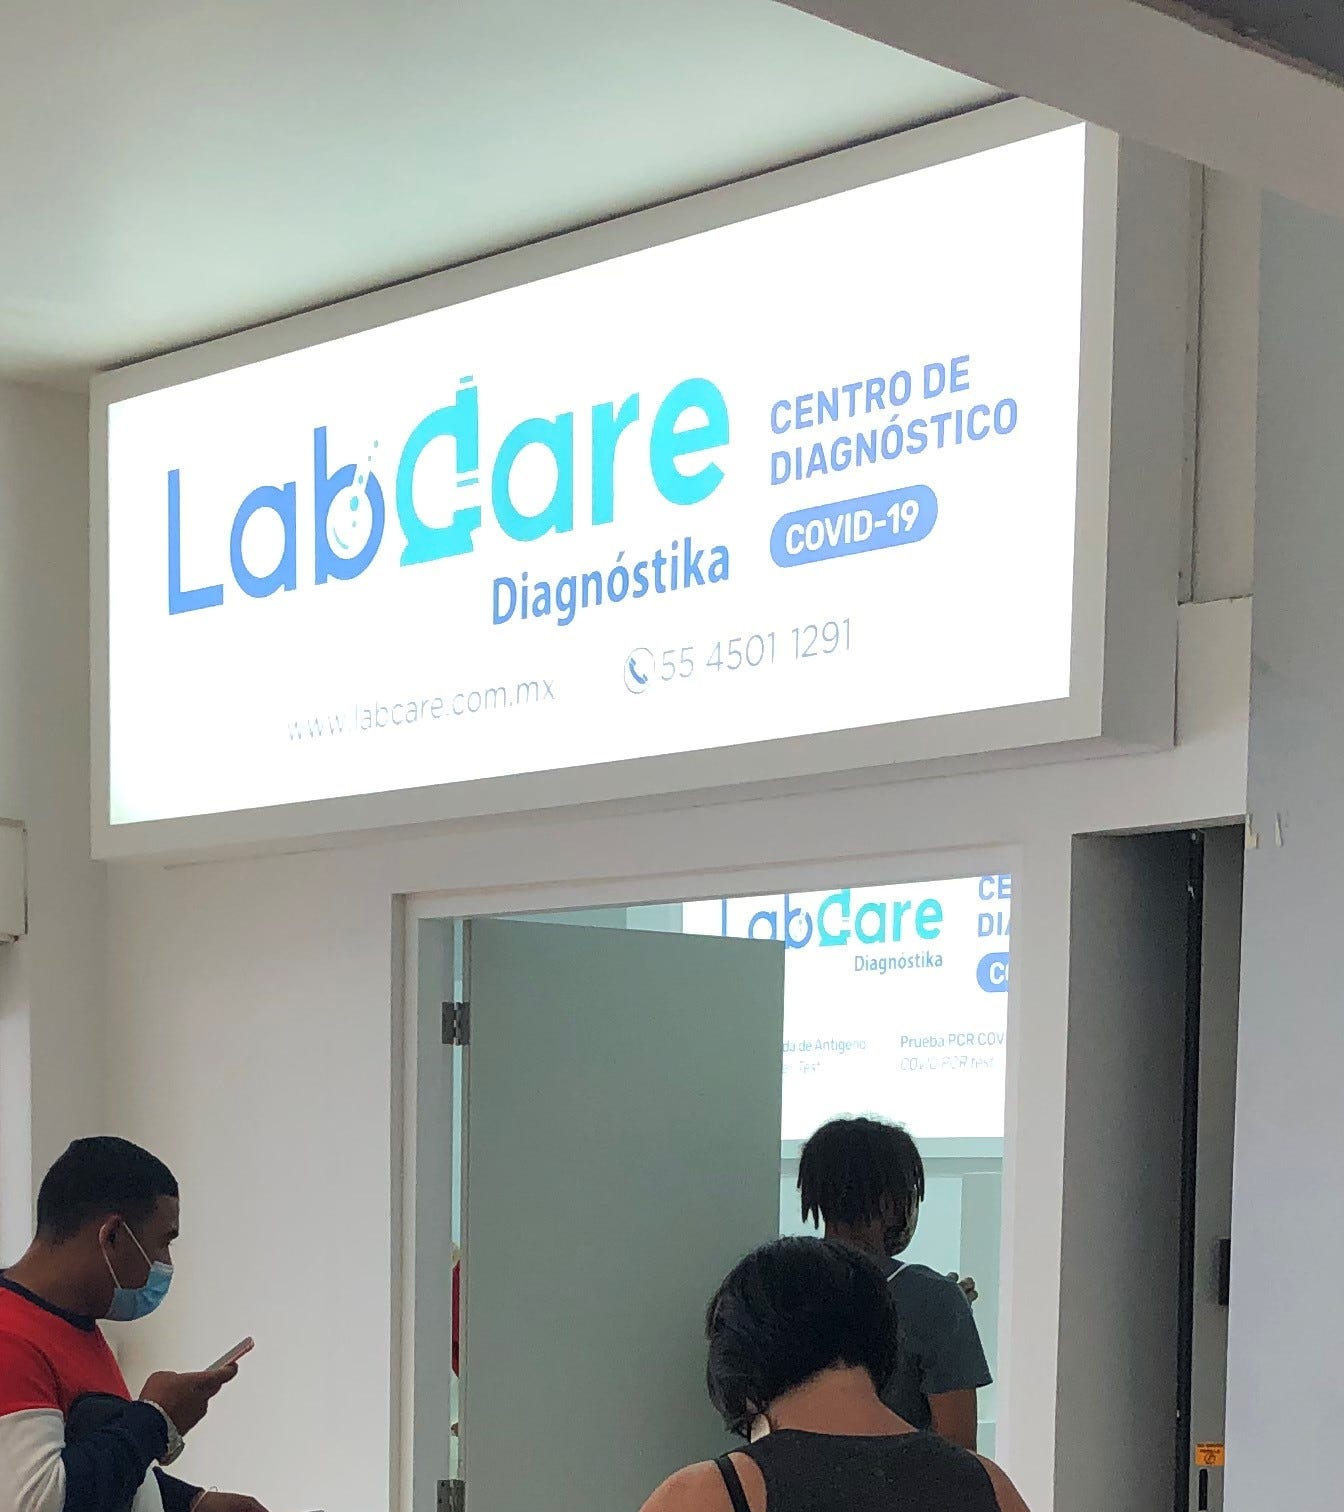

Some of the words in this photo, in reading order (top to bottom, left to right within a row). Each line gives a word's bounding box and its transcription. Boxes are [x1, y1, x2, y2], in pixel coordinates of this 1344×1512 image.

[770, 369, 912, 435] CENTRO
[923, 354, 970, 399] DE
[770, 397, 1018, 486] DIAGNÓSTICO
[167, 373, 730, 616] LabCare
[784, 499, 921, 556] COVID-19
[492, 536, 730, 627] Diagnóstika
[661, 647, 694, 681] 55
[706, 631, 775, 671] 4501
[791, 617, 850, 660] 1291
[854, 951, 943, 975] Diagnóstika
[948, 1032, 975, 1047] PCR
